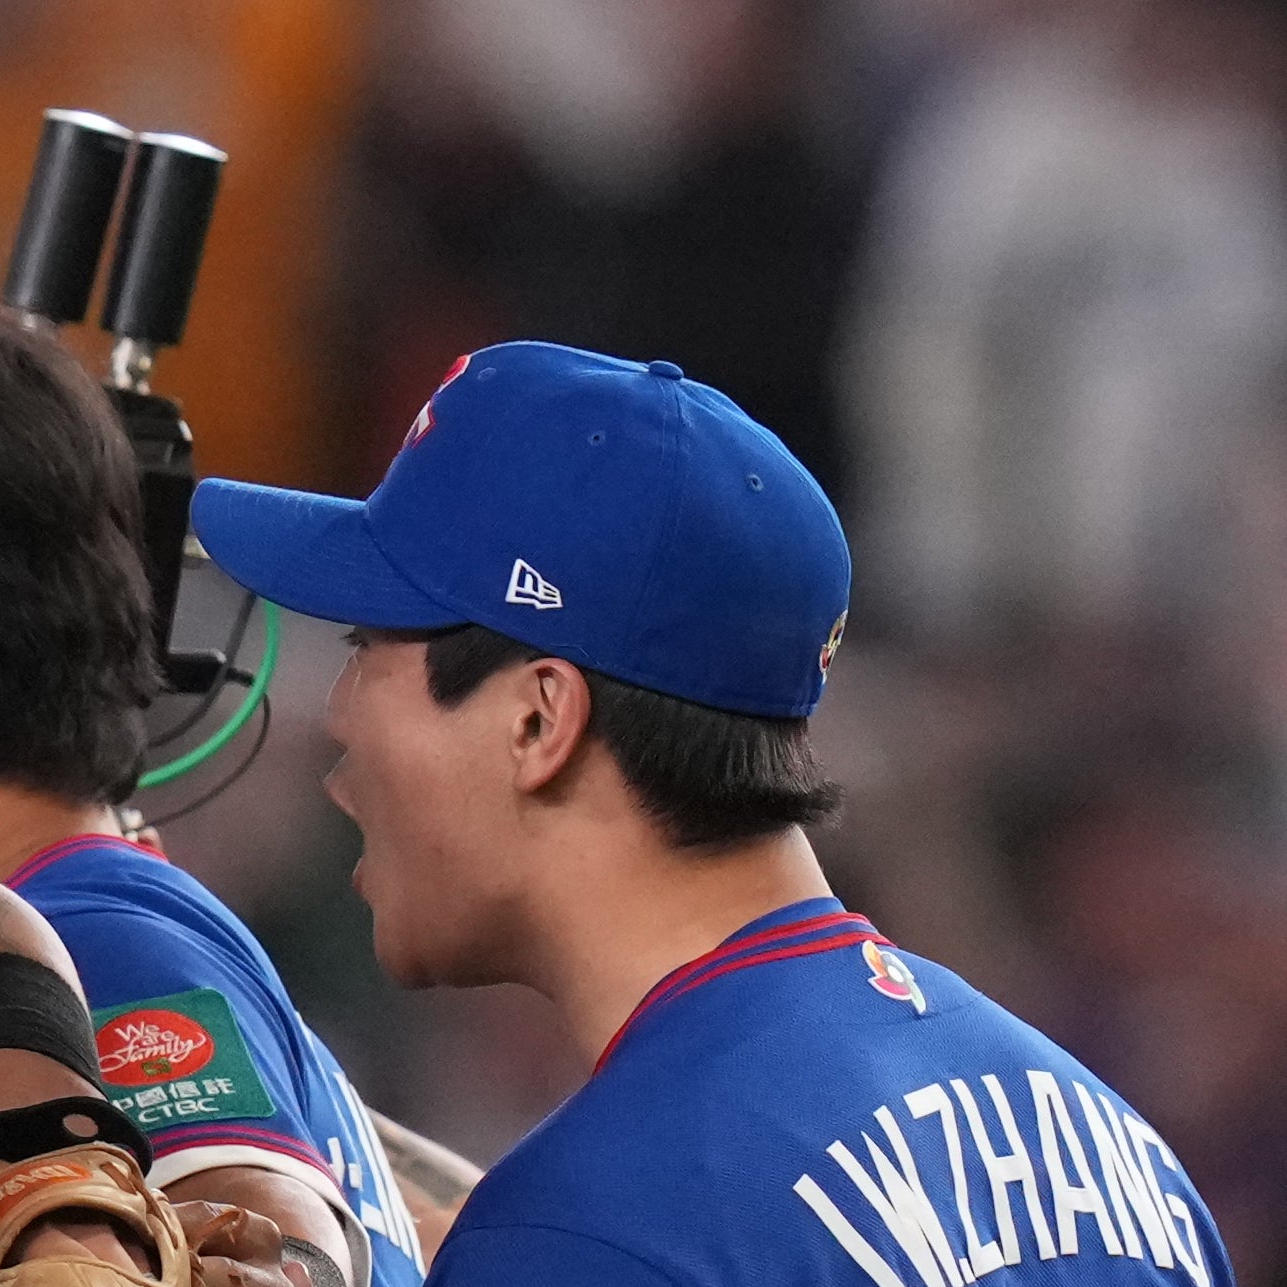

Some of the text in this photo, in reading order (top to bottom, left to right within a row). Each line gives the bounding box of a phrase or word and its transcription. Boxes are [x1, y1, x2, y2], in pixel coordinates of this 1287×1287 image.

[115, 1021, 160, 1042] We
[142, 1030, 176, 1046] are
[137, 1098, 220, 1123] CTBC
